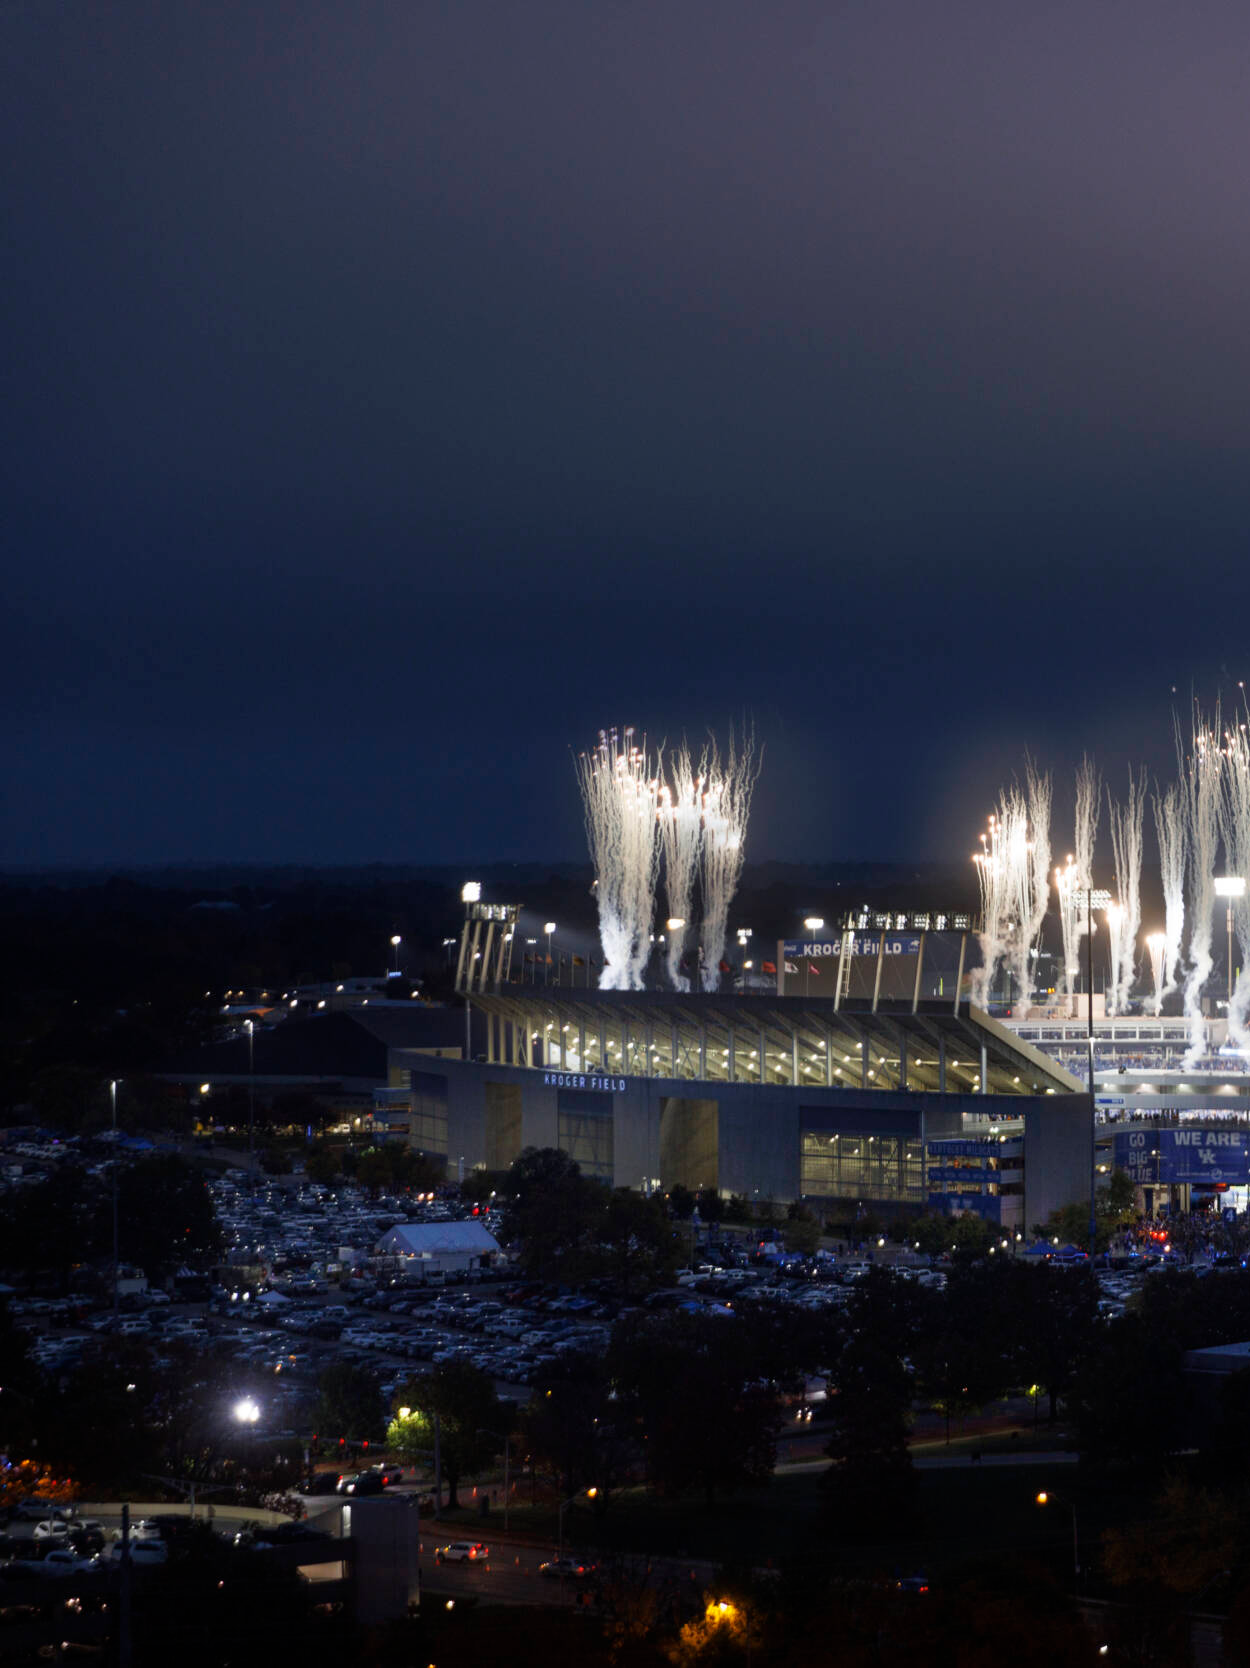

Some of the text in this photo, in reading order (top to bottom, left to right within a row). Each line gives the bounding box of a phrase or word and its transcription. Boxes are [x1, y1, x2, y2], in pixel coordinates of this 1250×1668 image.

[545, 1073, 626, 1091] KROGER FIELD
[1129, 1133, 1145, 1147] GO
[1174, 1132, 1240, 1146] WE ARE
[1128, 1151, 1147, 1165] BIG
[1226, 1210, 1234, 1222] 4
